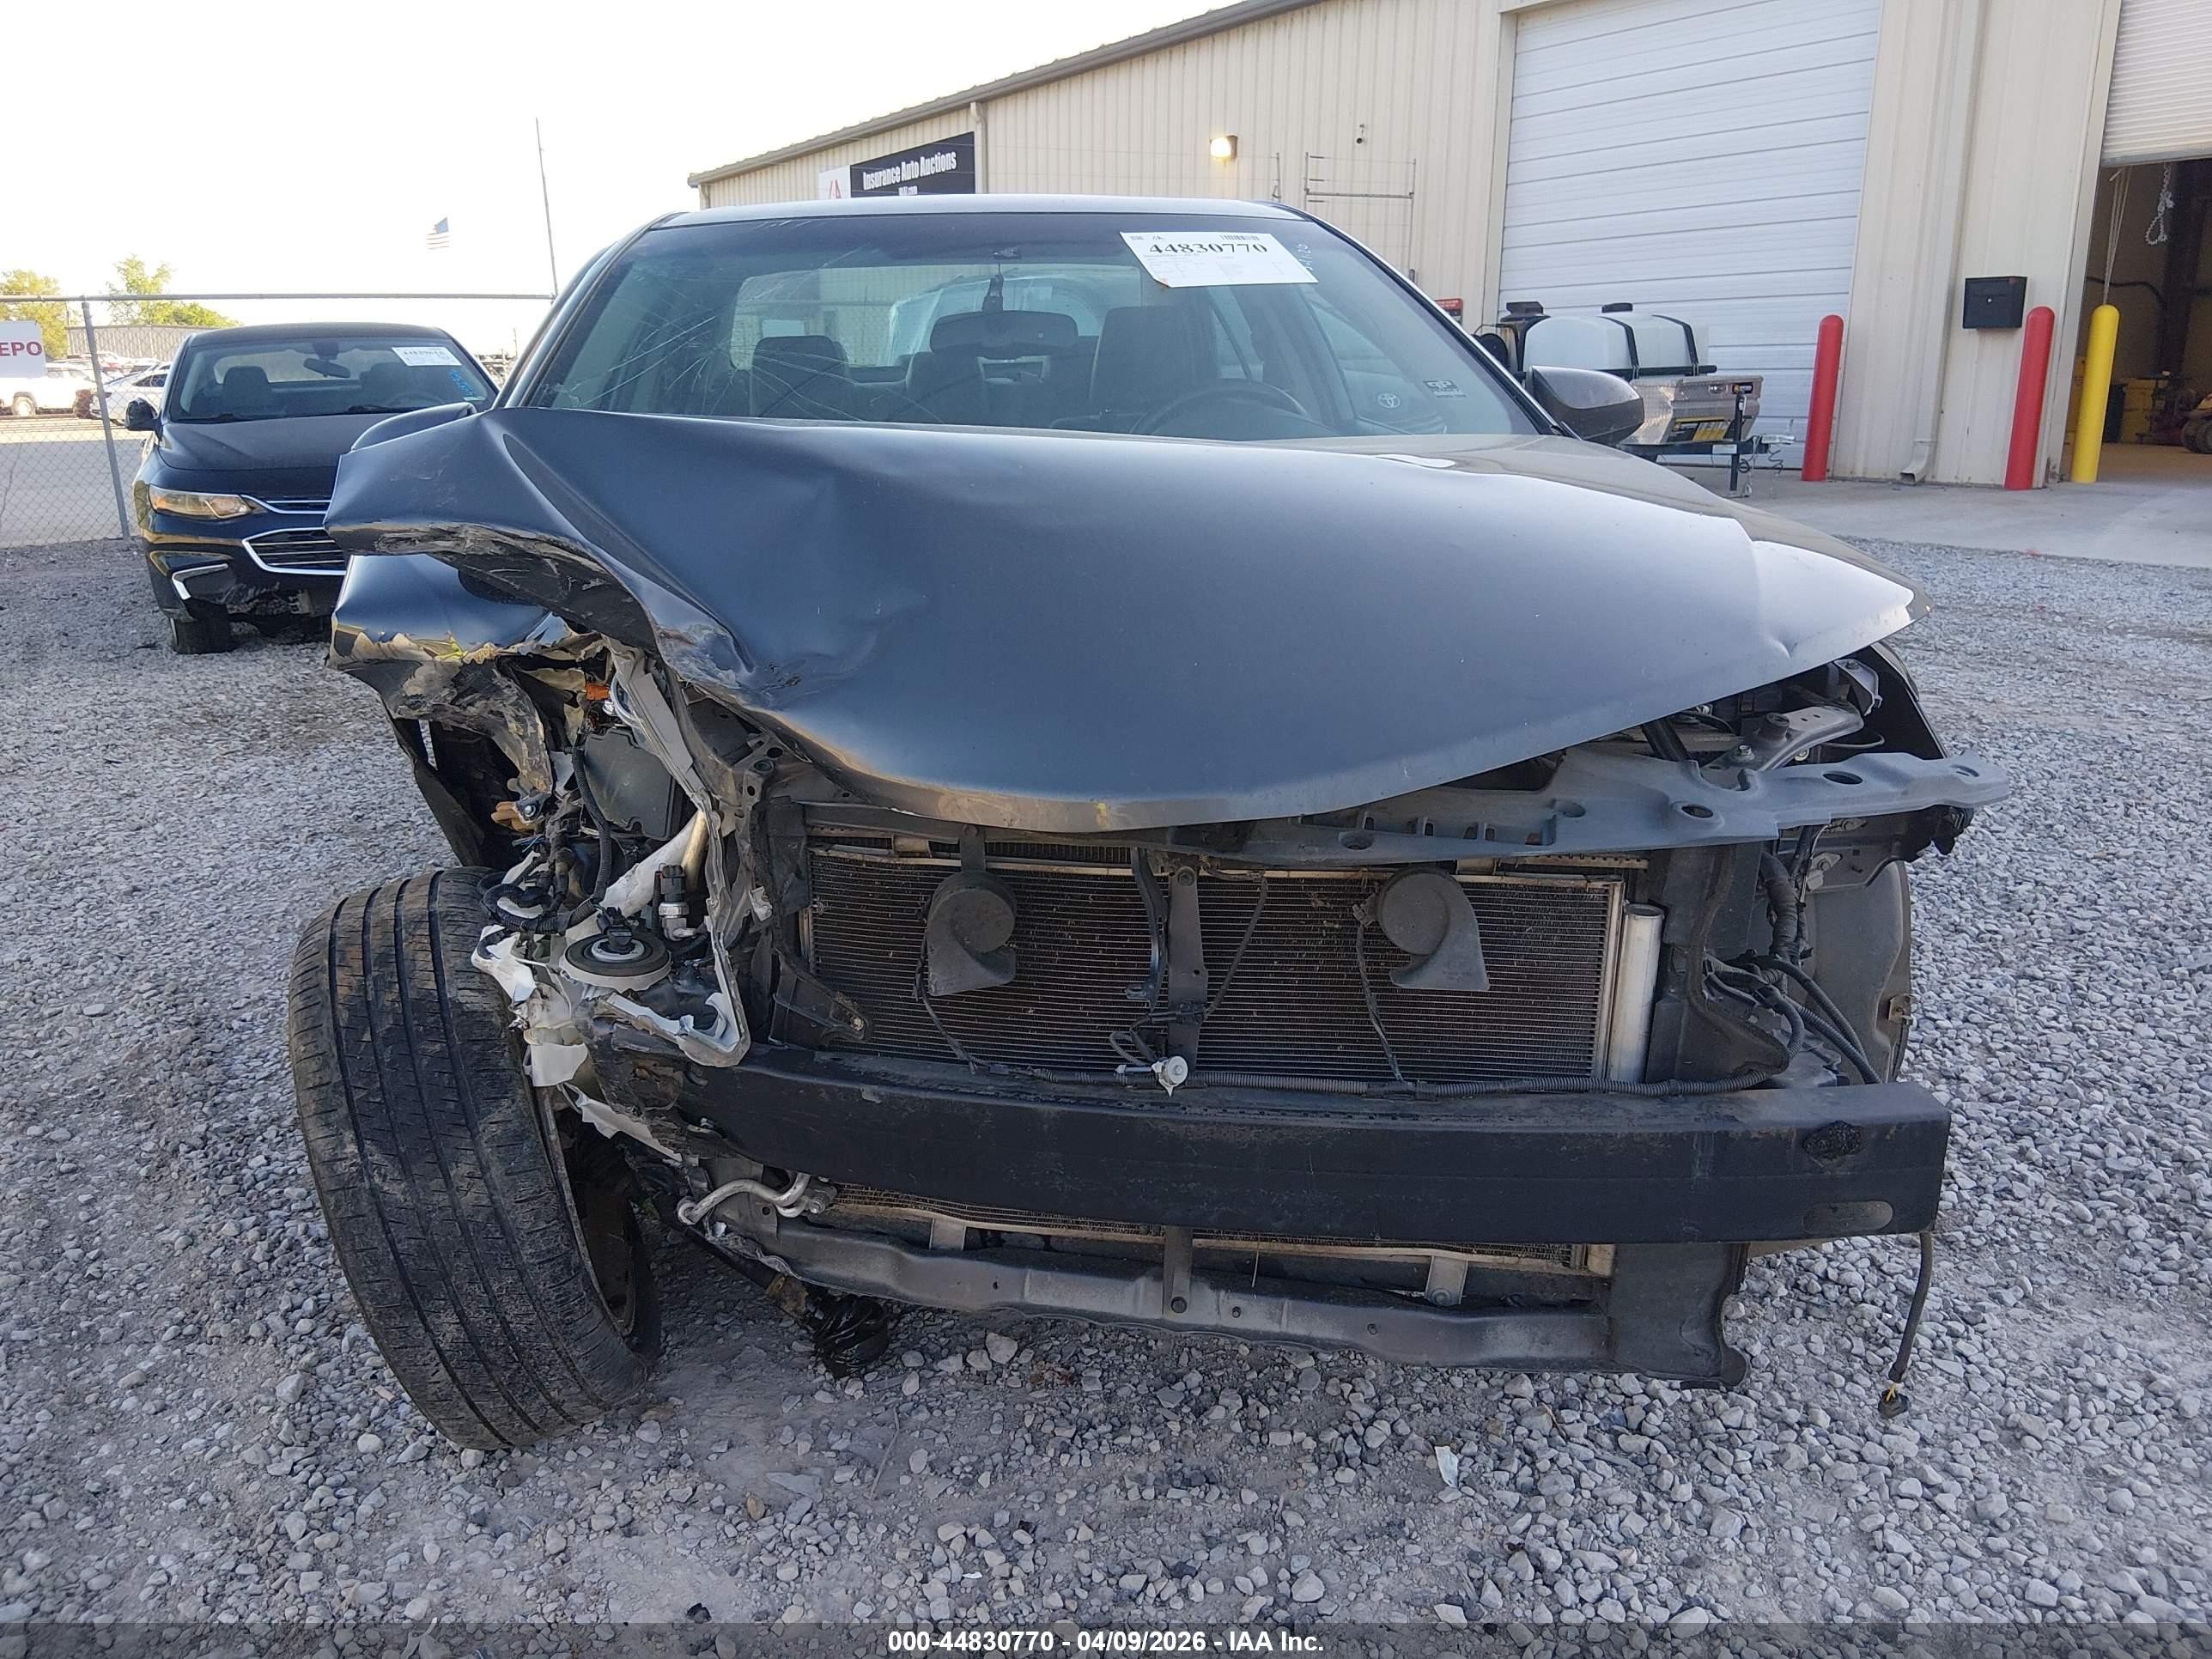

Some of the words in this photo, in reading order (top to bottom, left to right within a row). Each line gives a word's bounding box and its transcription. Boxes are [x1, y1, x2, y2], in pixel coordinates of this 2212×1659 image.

[863, 166, 901, 191] Insurance
[901, 161, 920, 182] Auto
[920, 151, 957, 177] Auctions
[1149, 243, 1267, 254] 44830770
